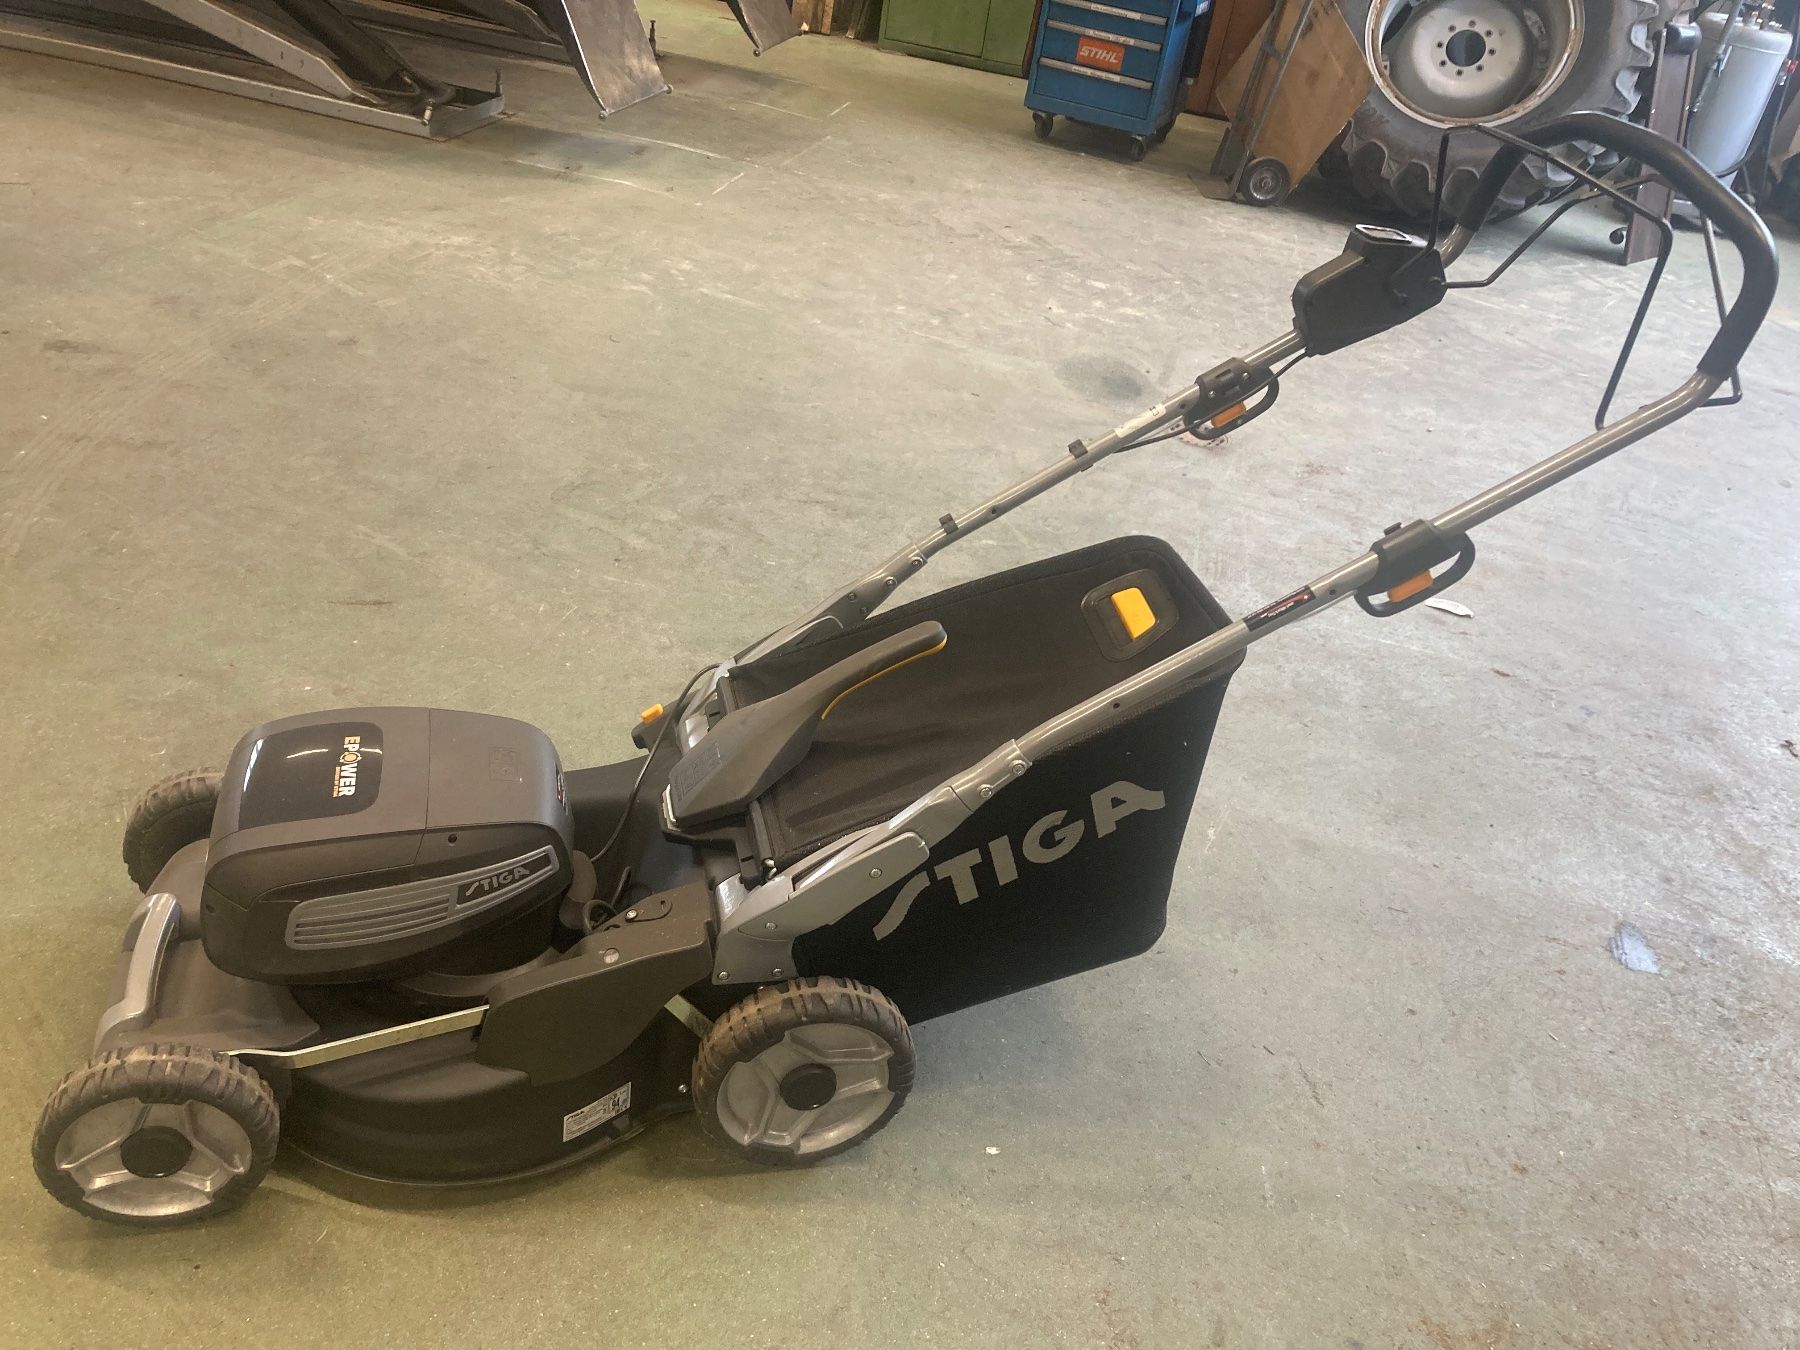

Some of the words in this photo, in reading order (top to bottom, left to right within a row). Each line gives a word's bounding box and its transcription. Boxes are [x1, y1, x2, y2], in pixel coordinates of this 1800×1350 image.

[1080, 46, 1119, 63] STIHL
[873, 780, 1166, 941] STIGA
[465, 866, 530, 896] STIGA
